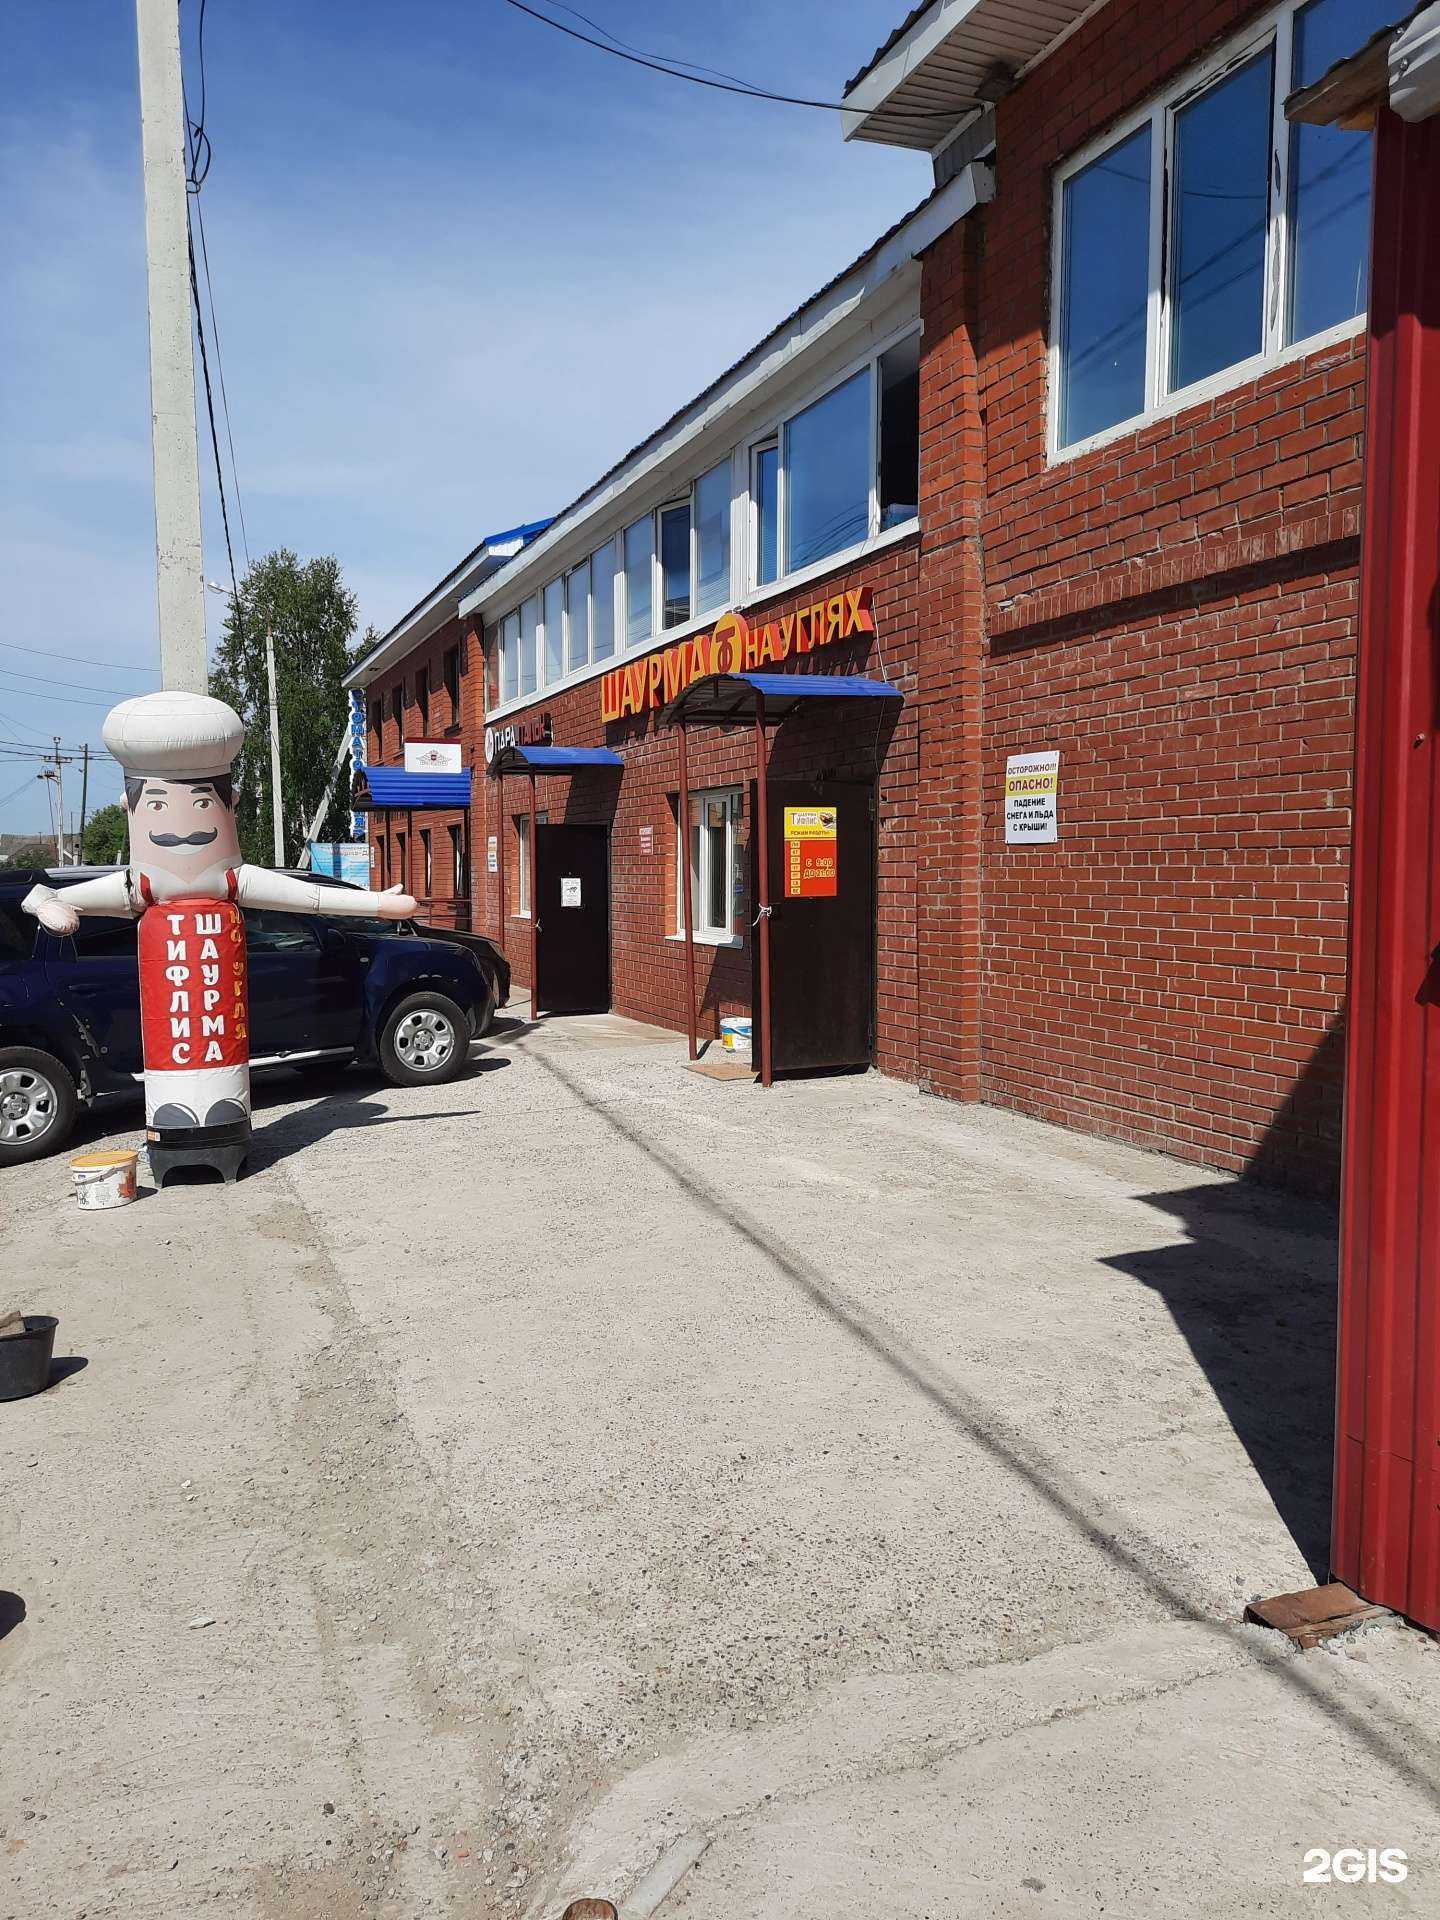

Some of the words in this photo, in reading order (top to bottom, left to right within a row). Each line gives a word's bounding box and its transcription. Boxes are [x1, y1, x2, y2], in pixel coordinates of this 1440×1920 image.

[601, 635, 712, 723] ШАУРМА
[745, 623, 784, 670] НА
[780, 586, 876, 658] УГЛЯХ
[1008, 763, 1057, 774] ОСТОРОЖНО!!!
[1008, 777, 1054, 791] ОПАСНО!
[1013, 797, 1046, 808] ПАДЕНИЕ
[1006, 811, 1028, 820] СНЕГА
[1028, 810, 1034, 819] И
[1034, 810, 1054, 820] ЛЬДА
[1013, 823, 1018, 832] С
[1019, 822, 1048, 832] КРЫШИ!
[165, 913, 192, 1065] ТИФЛИС
[194, 913, 225, 1063] ШАУРМА
